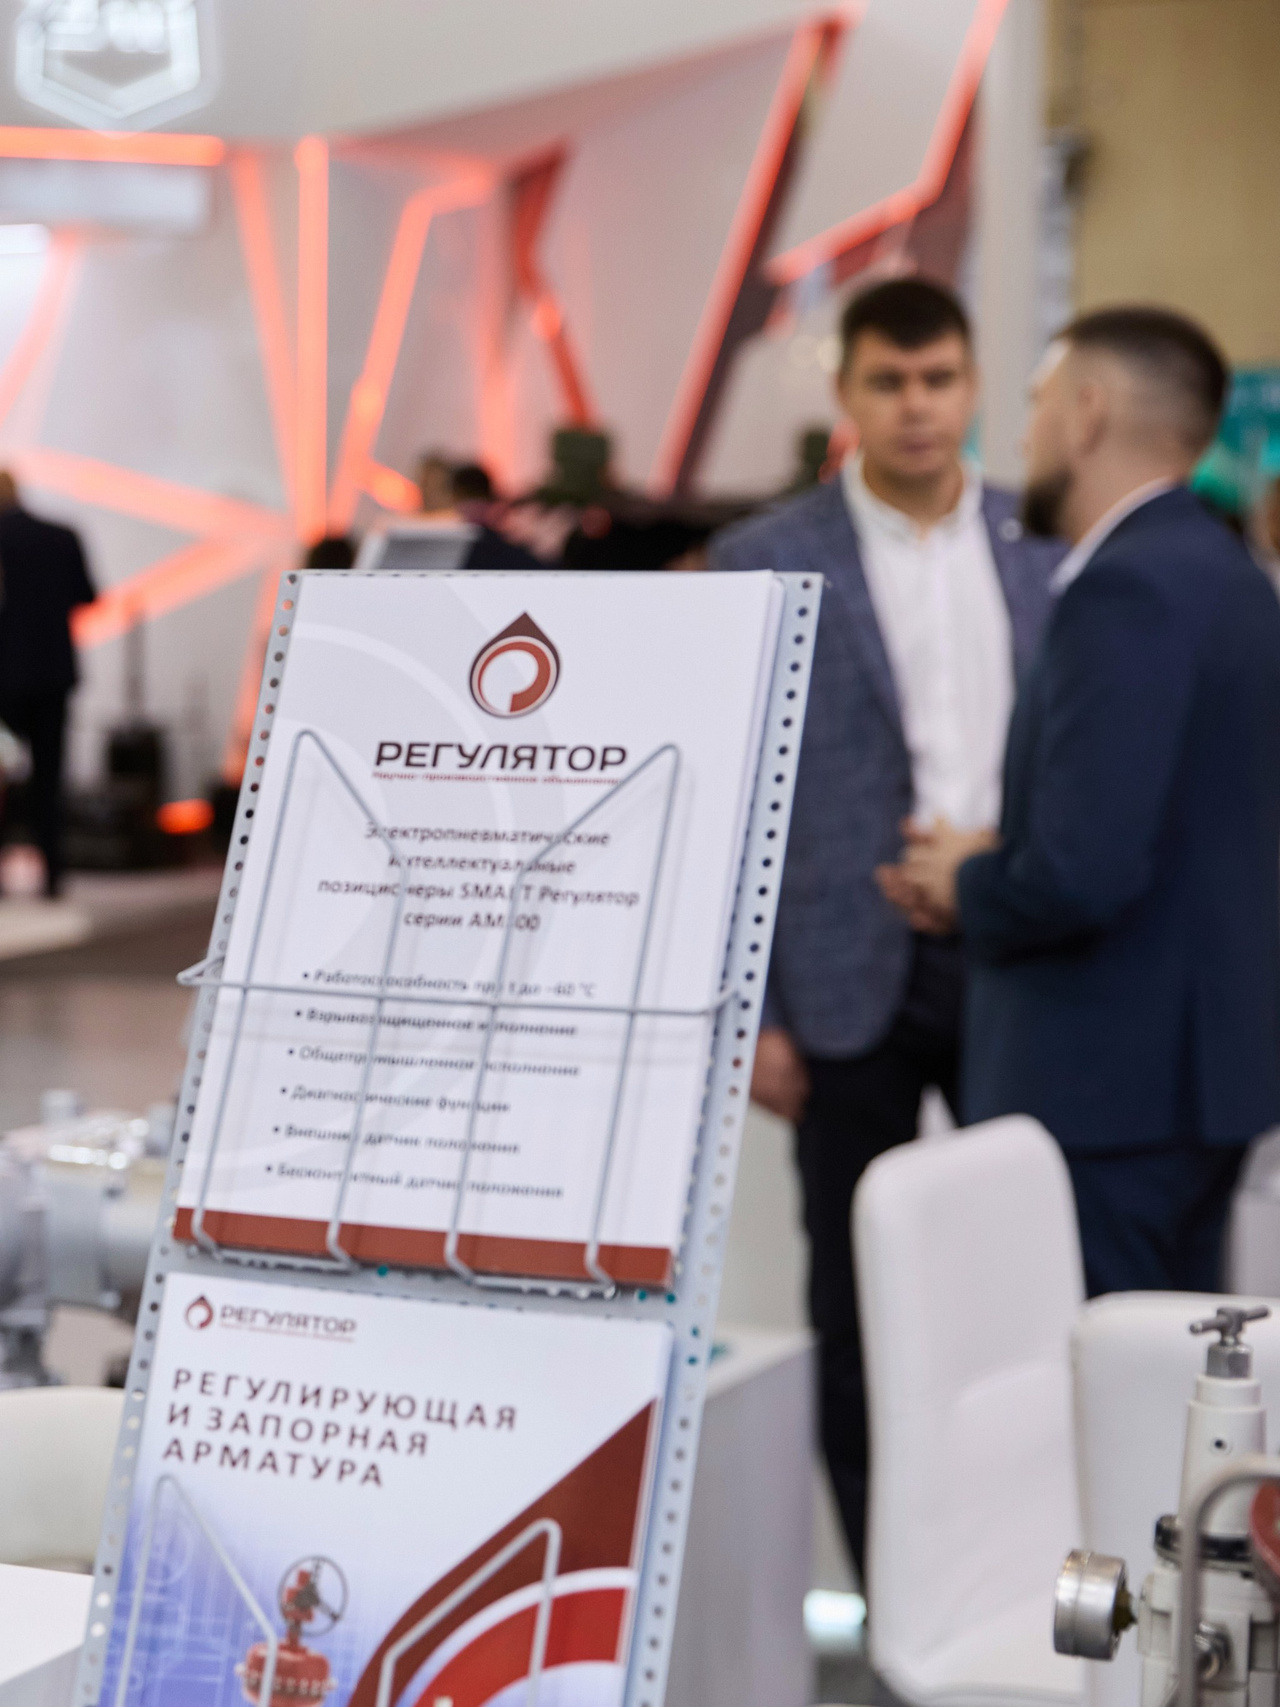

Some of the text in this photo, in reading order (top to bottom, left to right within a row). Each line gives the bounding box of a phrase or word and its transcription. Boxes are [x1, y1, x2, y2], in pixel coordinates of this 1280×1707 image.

[375, 742, 627, 771] РЕГУЛЯТОР
[365, 822, 610, 845] Эектропневматичские
[538, 884, 640, 908] Регулятор
[404, 910, 463, 928] серии
[478, 1019, 577, 1036] иполнение
[299, 1045, 474, 1070] Общепрмышленное
[290, 1085, 431, 1107] Диагносические
[285, 1124, 361, 1142] Внешни
[277, 1162, 402, 1187] Бесконтктный
[220, 1304, 357, 1333] РЕГУЛЯТОР
[173, 1367, 518, 1431] РЕГУЛИРУЮЩАЯ
[167, 1405, 429, 1457] И ЗАПОРНАЯ
[161, 1437, 385, 1488] АРМАТУРА
